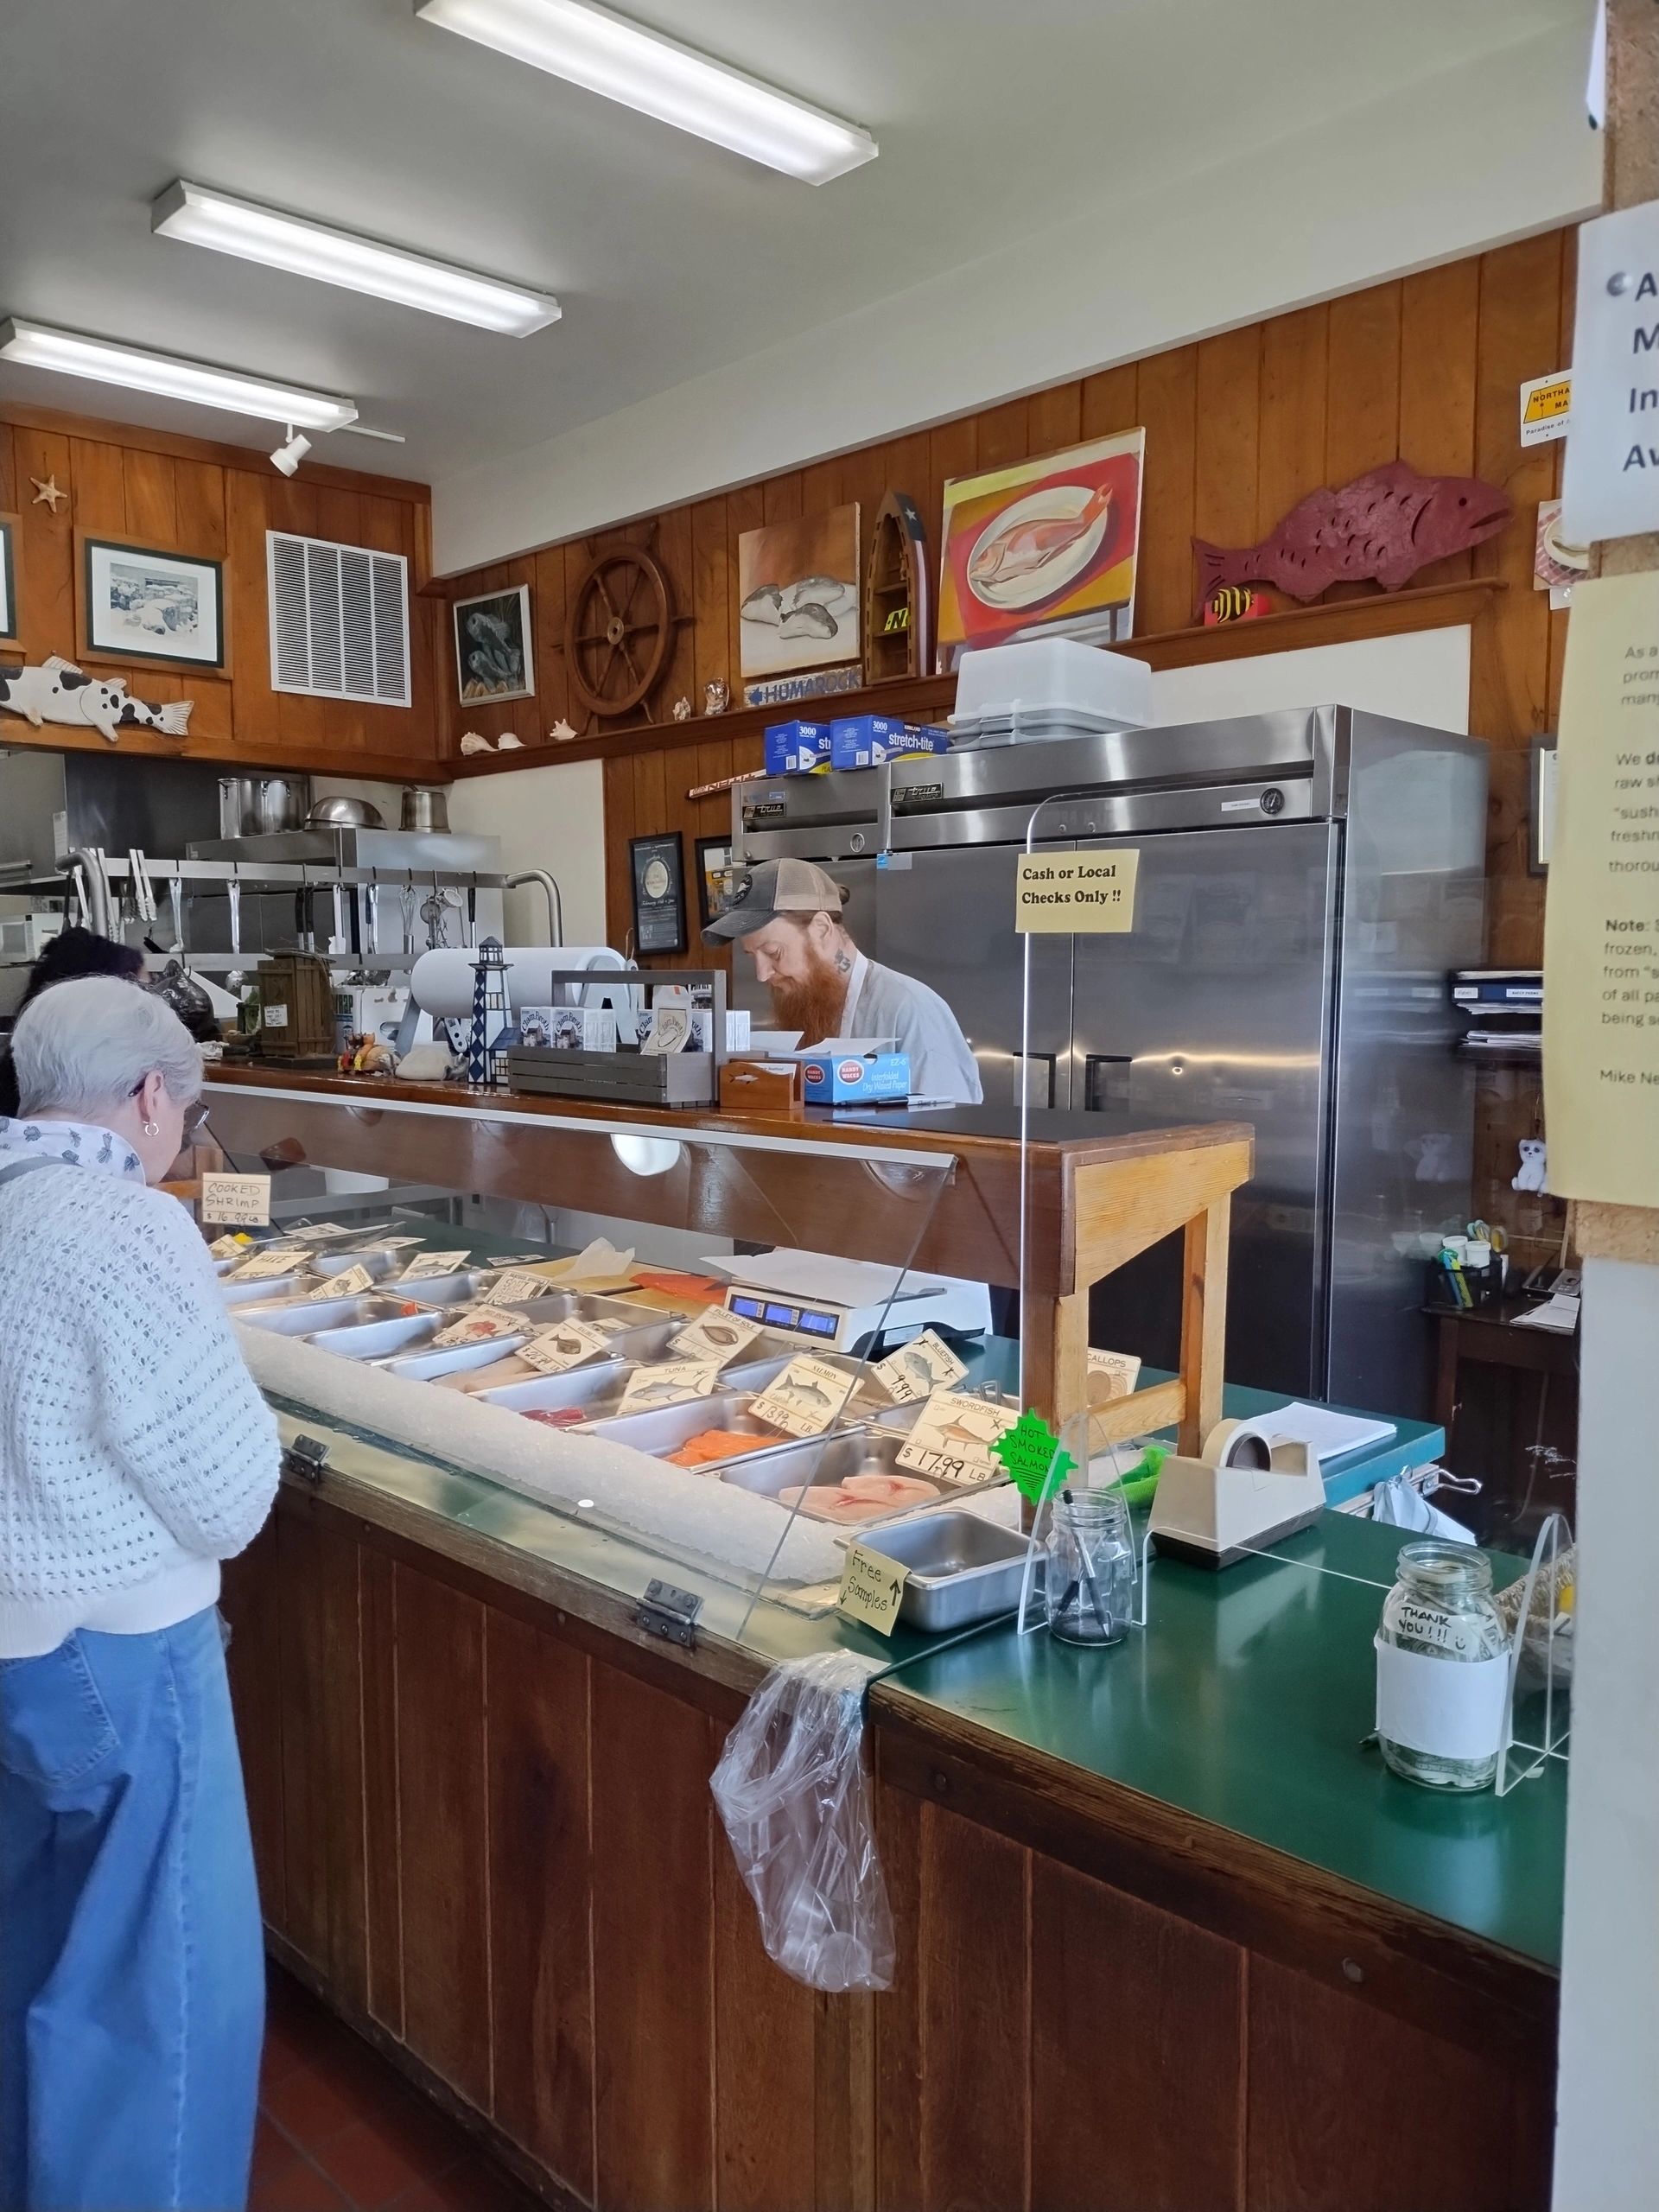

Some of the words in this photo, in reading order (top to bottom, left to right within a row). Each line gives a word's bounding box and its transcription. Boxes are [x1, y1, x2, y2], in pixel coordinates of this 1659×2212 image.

[1635, 272, 1657, 302] A
[1633, 323, 1659, 353] M
[1533, 387, 1570, 403] NORTHA
[1630, 388, 1658, 413] In
[1526, 423, 1554, 435] Paradise
[1625, 646, 1644, 658] As
[765, 670, 859, 703] HUMAROCK
[799, 726, 817, 736] 3000
[873, 721, 888, 731] 3000
[888, 733, 934, 750] stretch-tite
[1616, 753, 1641, 766] We
[1023, 868, 1054, 880] Cash
[1058, 869, 1074, 879] or
[1077, 865, 1116, 878] Local
[1021, 892, 1071, 904] Checks
[1074, 890, 1109, 905] Only
[1112, 890, 1122, 902] !!
[1604, 966, 1640, 978] from
[1602, 989, 1617, 1001] of
[1622, 989, 1639, 1001] all
[1602, 1012, 1644, 1028] being
[1600, 1070, 1636, 1084] Mike
[208, 1182, 261, 1197] COOKED
[206, 1193, 259, 1208] SHRIMP
[714, 1309, 732, 1319] FILLET
[741, 1320, 757, 1330] SOLE
[932, 1342, 955, 1365] BLUEFISH
[812, 1366, 837, 1380] SALMON
[950, 1397, 1001, 1417] SWORDFISH
[1020, 1424, 1046, 1439] HOT
[969, 1468, 986, 1482] LB
[851, 1549, 881, 1583] Free
[848, 1575, 888, 1611] Samples
[1401, 1606, 1452, 1628] THANK
